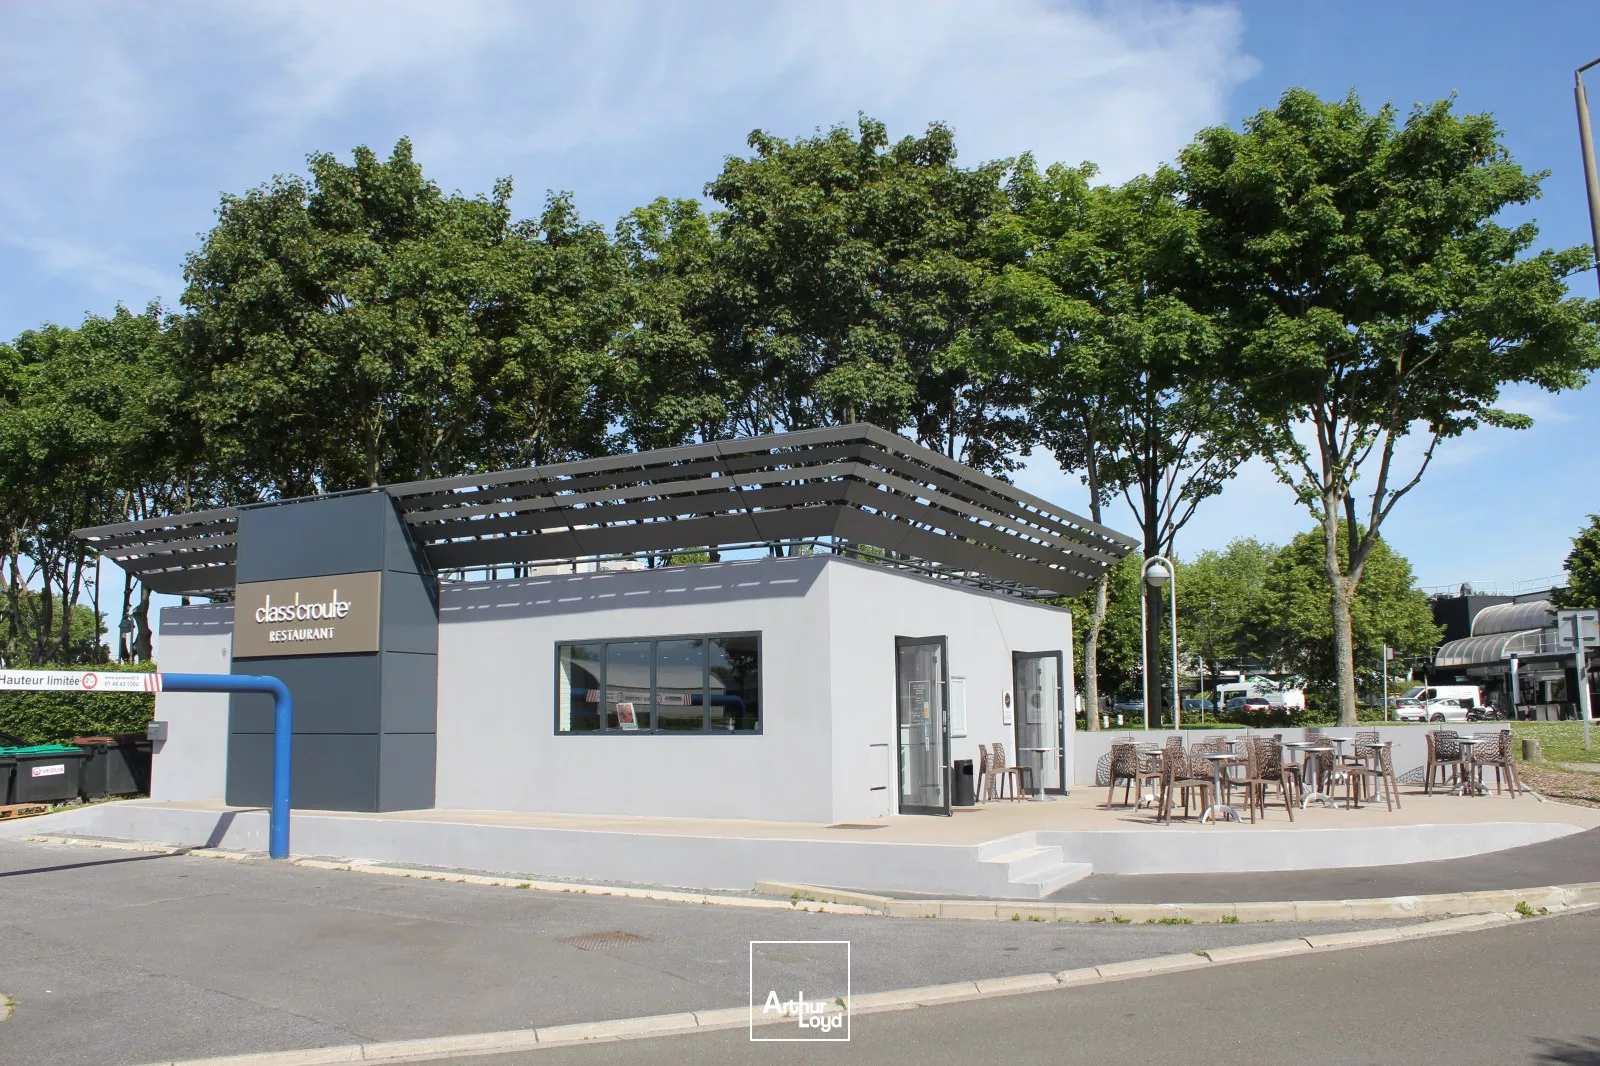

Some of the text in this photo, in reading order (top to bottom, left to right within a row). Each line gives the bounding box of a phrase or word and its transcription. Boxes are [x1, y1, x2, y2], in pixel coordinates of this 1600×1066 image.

[269, 627, 335, 642] RESTAURANT
[0, 674, 80, 686] Hauteur limitée
